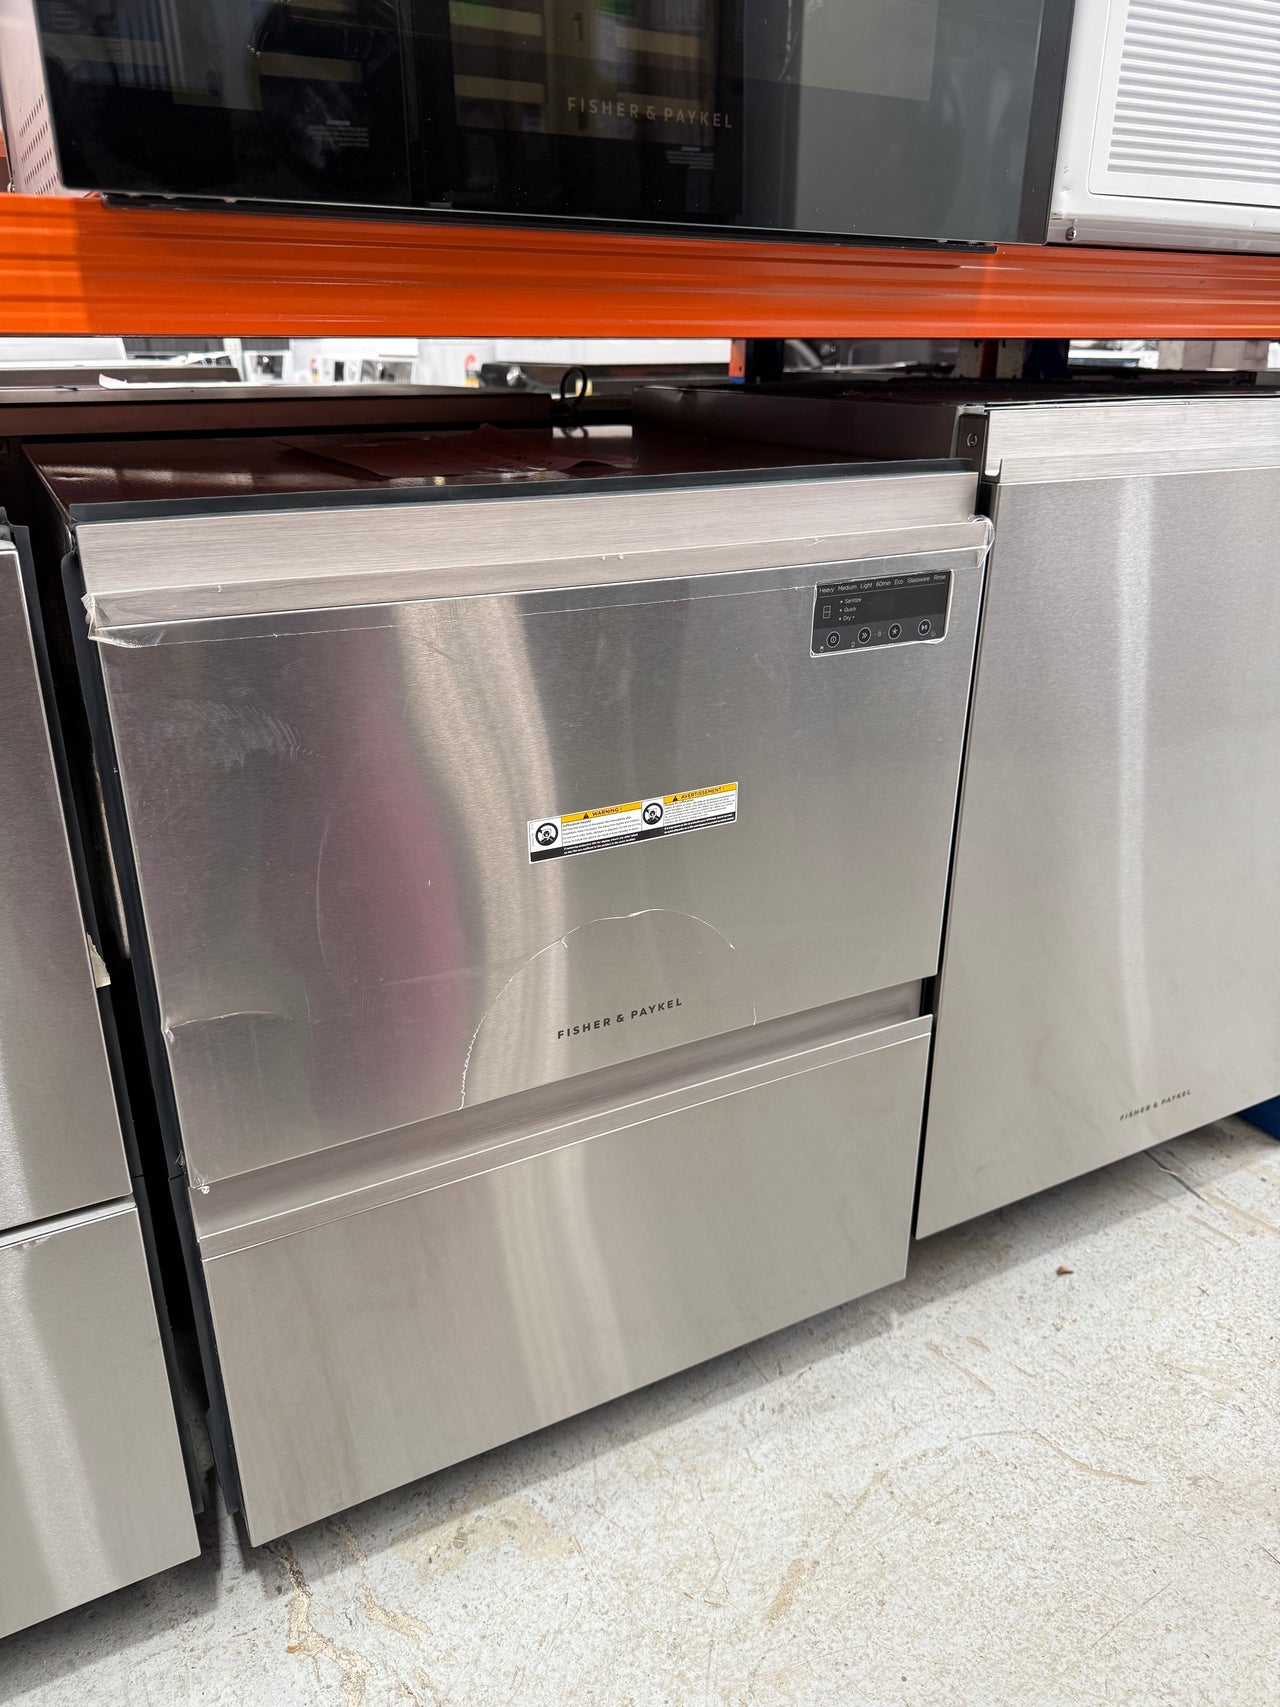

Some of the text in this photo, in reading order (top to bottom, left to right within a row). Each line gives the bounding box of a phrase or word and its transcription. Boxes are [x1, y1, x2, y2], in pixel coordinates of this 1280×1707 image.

[567, 96, 733, 129] FISHER & PAYKEL
[837, 584, 857, 592] Medium
[860, 582, 873, 590] Light
[875, 580, 892, 588] 60min
[907, 576, 930, 584] Glassware
[681, 787, 722, 799] AVERTISSEMENT
[591, 807, 619, 817] WARNING
[558, 998, 682, 1039] FISHER & PAYKEL
[1120, 1104, 1151, 1120] FISHER
[1161, 1089, 1191, 1104] PAYKEL
